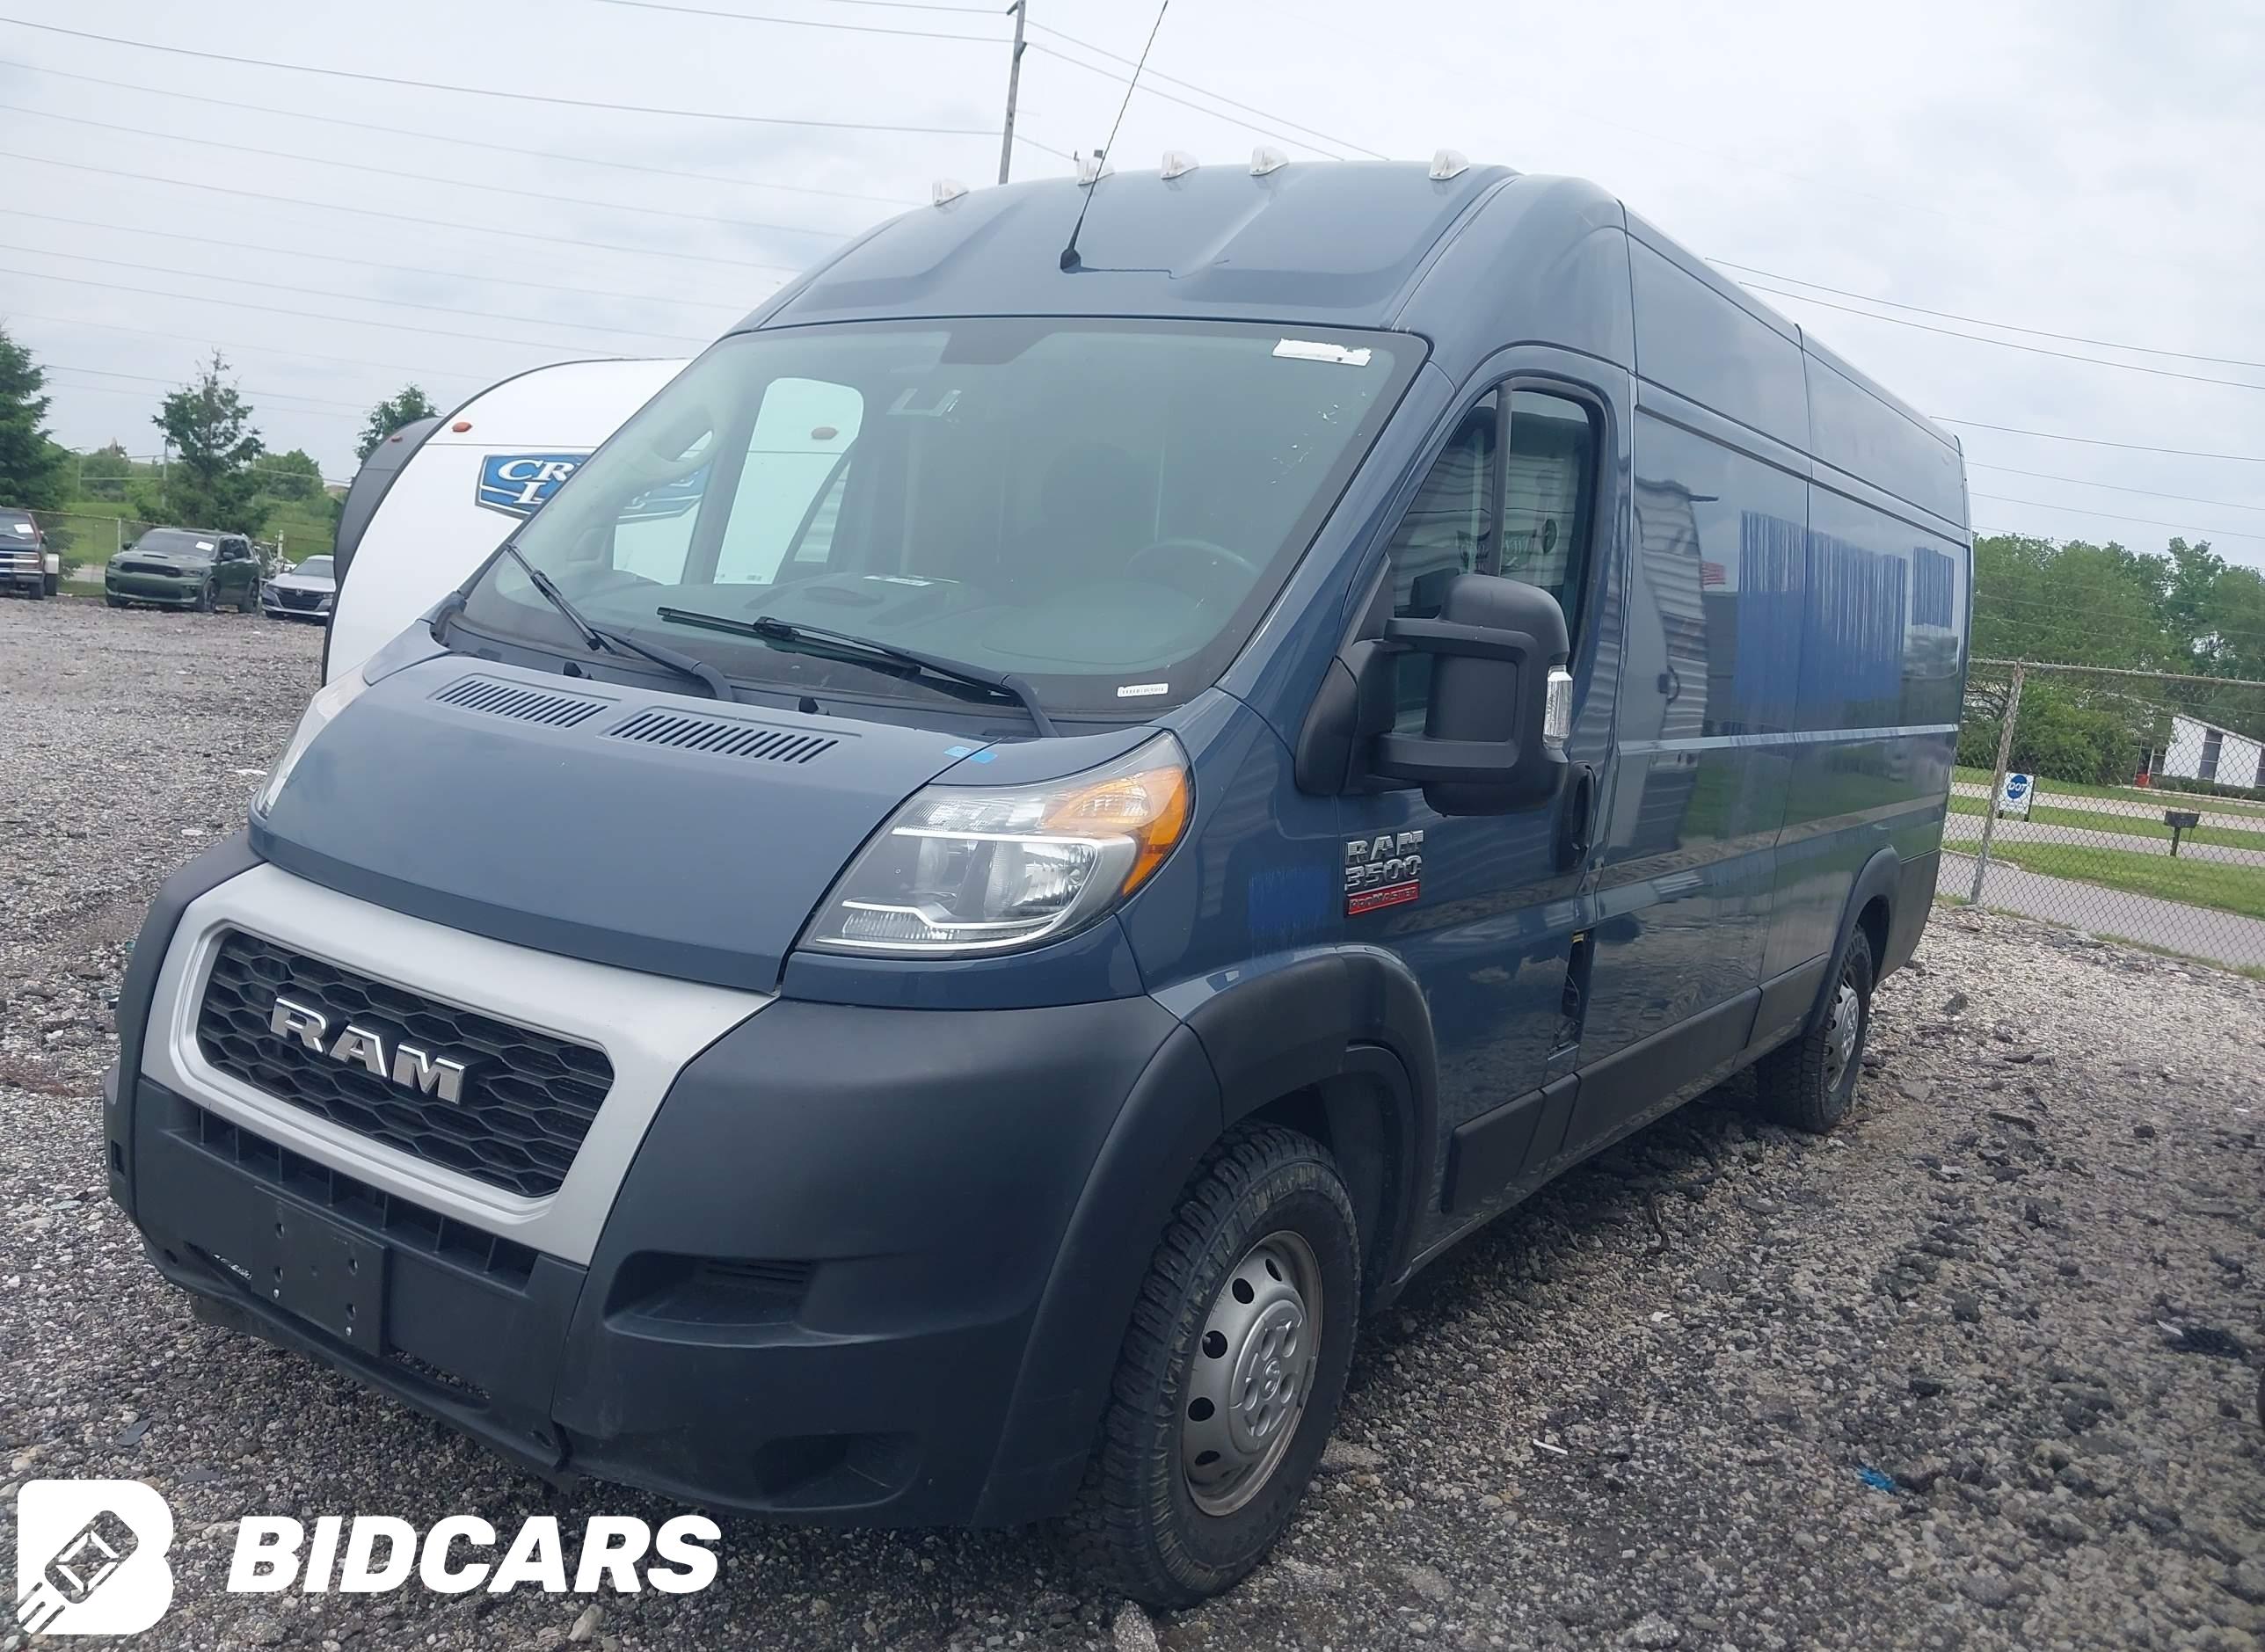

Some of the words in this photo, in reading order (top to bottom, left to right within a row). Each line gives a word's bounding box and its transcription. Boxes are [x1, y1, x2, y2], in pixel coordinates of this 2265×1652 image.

[2008, 782, 2028, 792] DOT
[1345, 829, 1424, 865] RAM
[1344, 855, 1423, 891] 3500
[270, 996, 467, 1105] RAM
